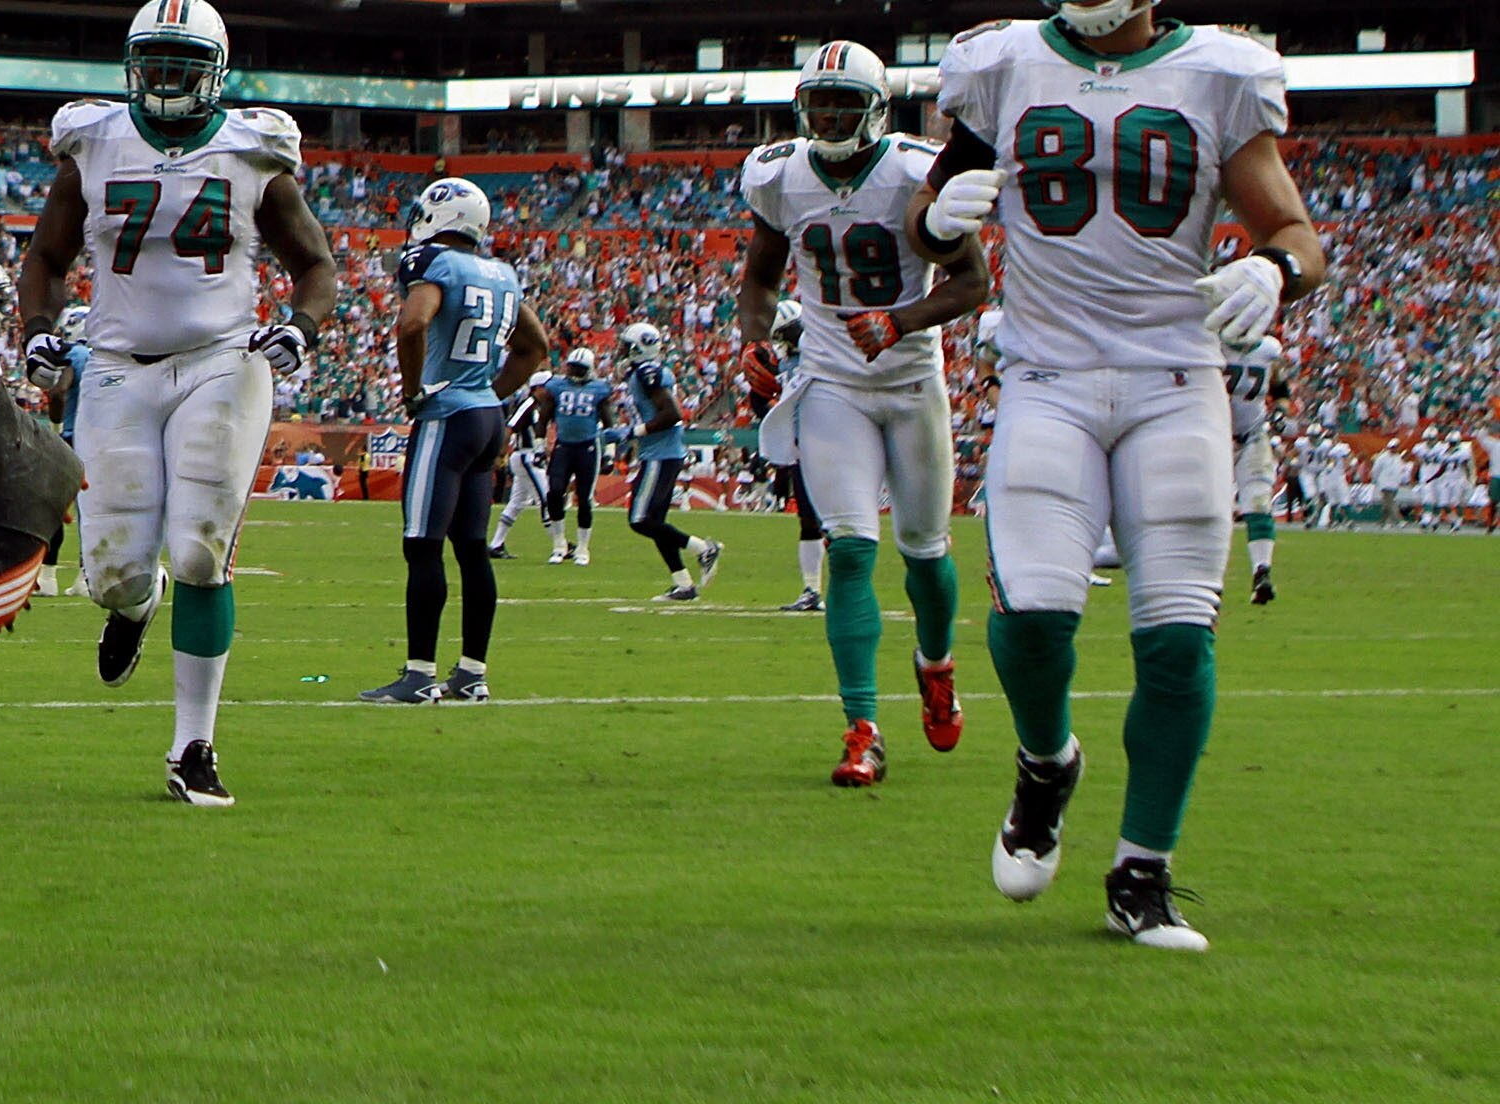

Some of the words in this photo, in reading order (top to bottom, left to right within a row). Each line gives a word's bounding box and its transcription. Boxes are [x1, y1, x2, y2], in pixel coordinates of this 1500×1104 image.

[509, 79, 633, 109] FINS
[650, 73, 746, 106] UP!
[1013, 103, 1198, 238] 80
[104, 177, 235, 276] 74
[802, 223, 904, 307] 19
